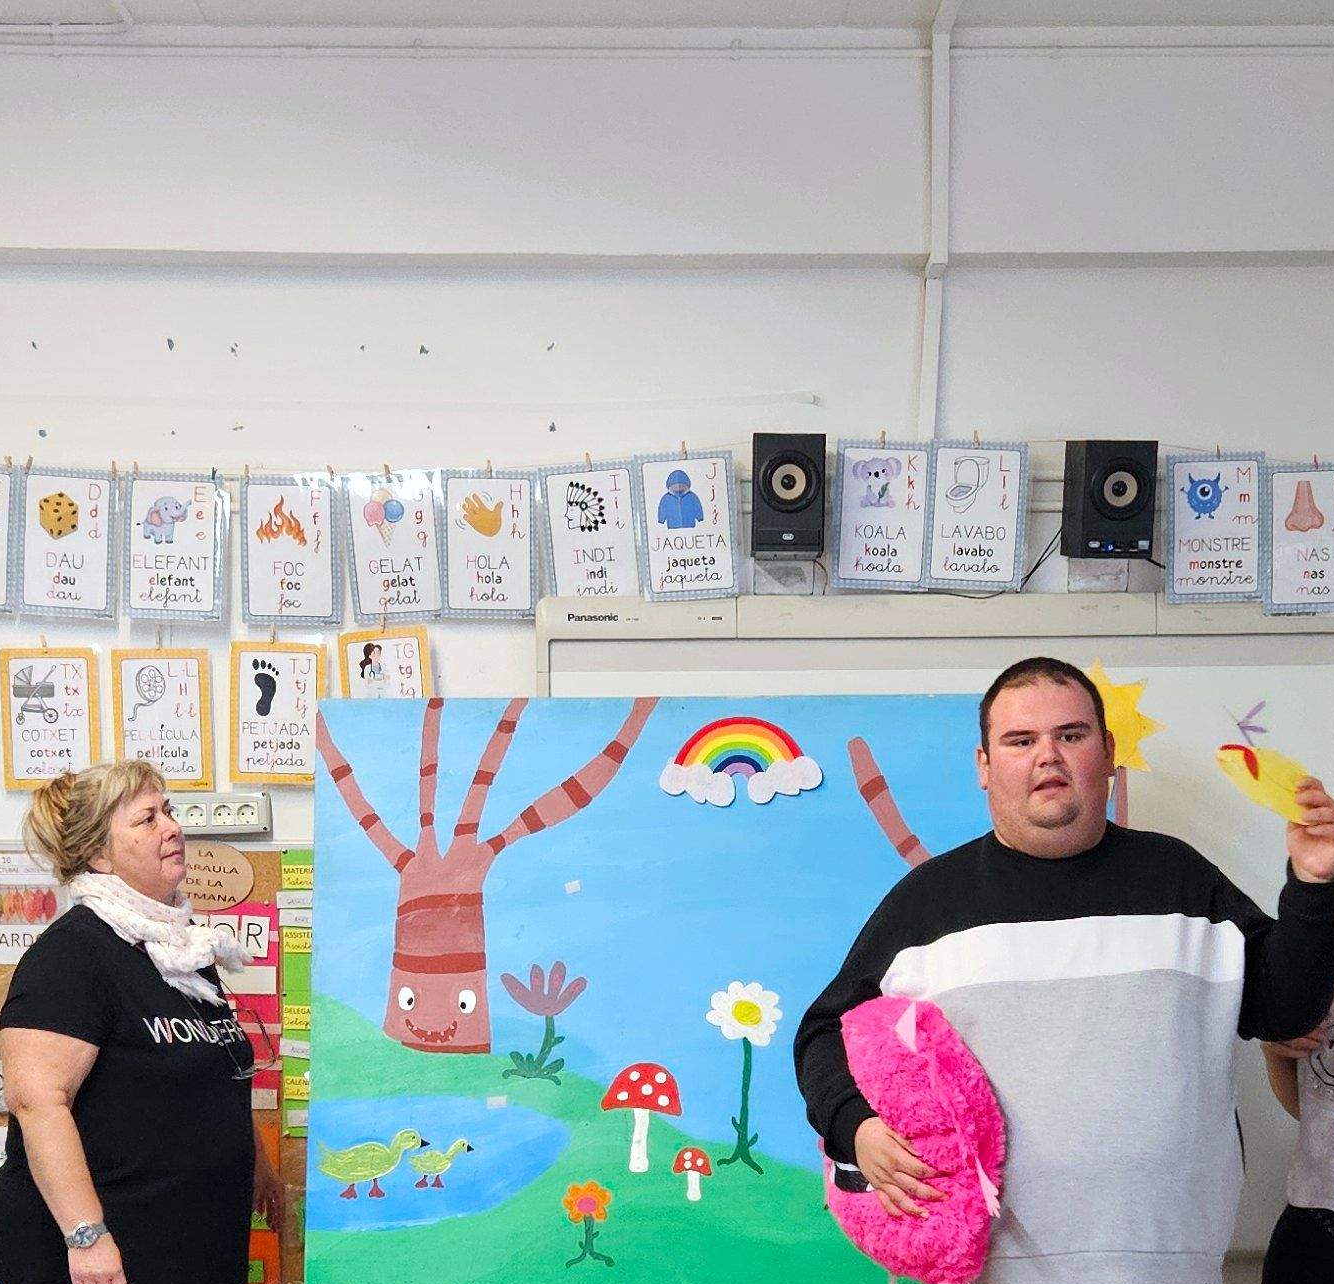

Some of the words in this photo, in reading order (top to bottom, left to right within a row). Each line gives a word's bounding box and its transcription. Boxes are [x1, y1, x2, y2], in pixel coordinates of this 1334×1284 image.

[705, 463, 718, 480] J
[907, 455, 918, 472] K
[999, 455, 1011, 472] L
[609, 474, 622, 493] I
[1236, 467, 1252, 485] M
[88, 484, 102, 500] D
[194, 486, 207, 503] E
[310, 491, 320, 506] F
[509, 484, 523, 501] H
[854, 524, 907, 542] KOALA
[941, 524, 1006, 542] LAVABO
[652, 533, 727, 552] JAQUETA
[1179, 536, 1251, 554] MONSTRE
[573, 547, 616, 564] INDI
[864, 545, 898, 557] koala
[953, 544, 994, 558] lavabo
[1296, 548, 1331, 563] NAS
[46, 552, 85, 570] DAU
[132, 554, 210, 571] ELEFANT
[273, 561, 305, 577] FOC
[369, 558, 422, 574] GELAT
[466, 556, 510, 570] HOLA
[667, 554, 716, 573] jaqueta
[854, 557, 903, 574] koala
[943, 557, 1000, 574] lavabo
[1190, 557, 1243, 570] monstre
[52, 572, 76, 586] dau
[148, 573, 195, 588] elefant
[476, 571, 503, 585] hola
[586, 567, 607, 581] indi
[660, 569, 723, 589] jaqueta
[1176, 571, 1255, 587] monstre
[1303, 568, 1325, 580] nas
[280, 578, 301, 591] foc
[383, 575, 416, 592] gelat
[1297, 582, 1330, 596] nas
[46, 587, 82, 601] dau
[139, 587, 202, 605] elefant
[378, 592, 421, 609] gelat
[470, 585, 508, 602] hola
[277, 593, 302, 613] foc
[567, 613, 618, 622] Panasonic
[392, 643, 415, 659] TG
[61, 664, 83, 679] TX
[290, 659, 312, 676] TJ
[398, 665, 413, 680] tg
[65, 685, 79, 696] tx
[294, 678, 306, 694] tj
[21, 729, 79, 742] COTXET
[242, 722, 311, 736] PETJADA
[29, 746, 73, 758] cotxet
[253, 739, 301, 752] petjada
[198, 850, 214, 858] LA
[207, 879, 223, 887] LA
